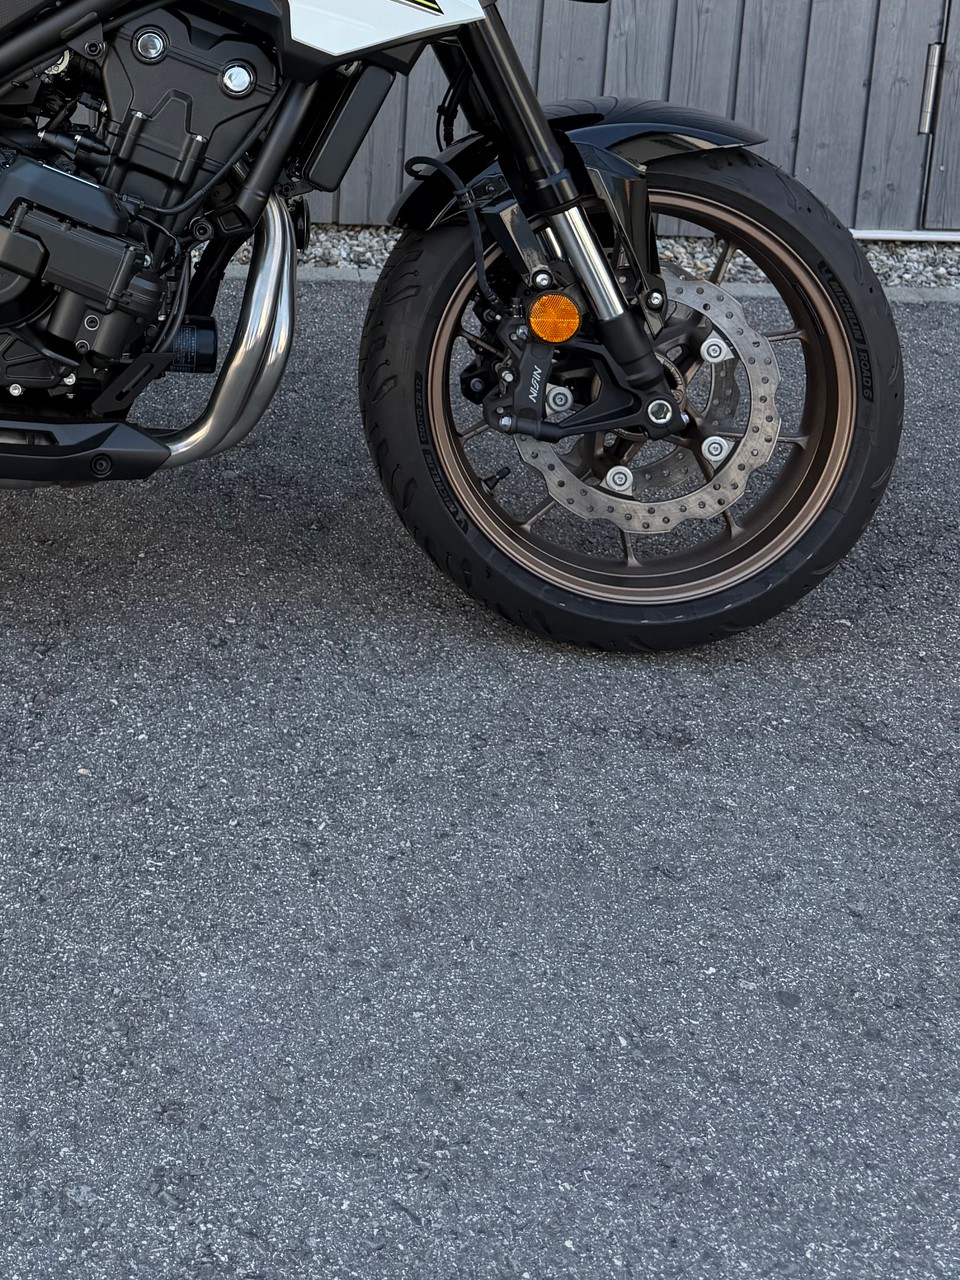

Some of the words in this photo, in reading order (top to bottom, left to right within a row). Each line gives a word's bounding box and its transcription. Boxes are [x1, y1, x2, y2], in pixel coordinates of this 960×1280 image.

[829, 279, 863, 343] MICHELIN
[528, 364, 542, 403] NISSIN
[858, 351, 872, 389] ROAD
[863, 390, 873, 401] 6
[424, 453, 457, 513] MICHELIN
